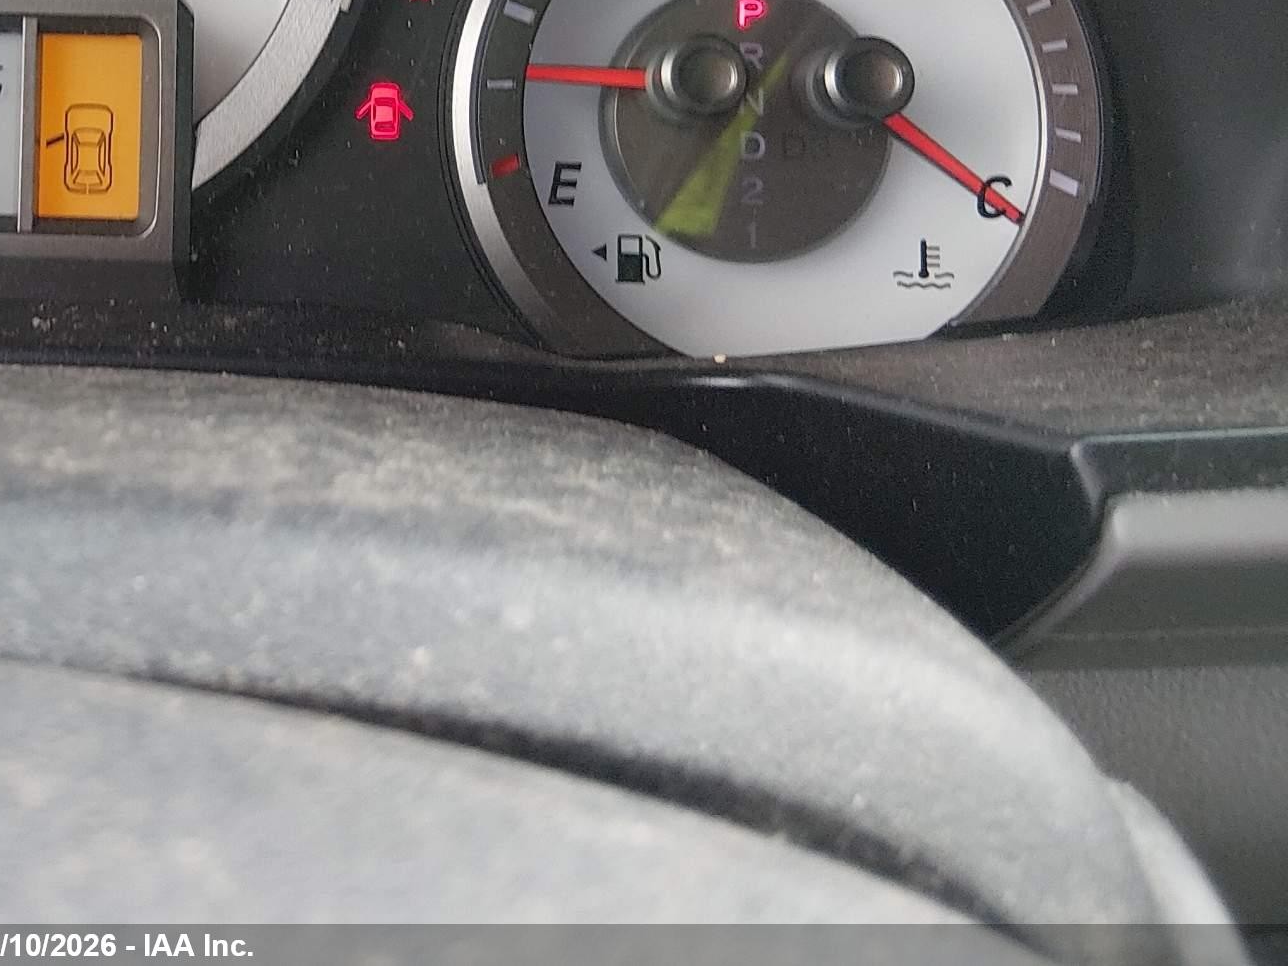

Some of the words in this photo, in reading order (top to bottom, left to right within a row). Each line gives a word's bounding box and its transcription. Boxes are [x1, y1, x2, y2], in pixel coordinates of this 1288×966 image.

[739, 42, 763, 70] R
[740, 131, 765, 159] D
[548, 162, 581, 205] E
[742, 177, 763, 204] 2
[976, 176, 1012, 218] C
